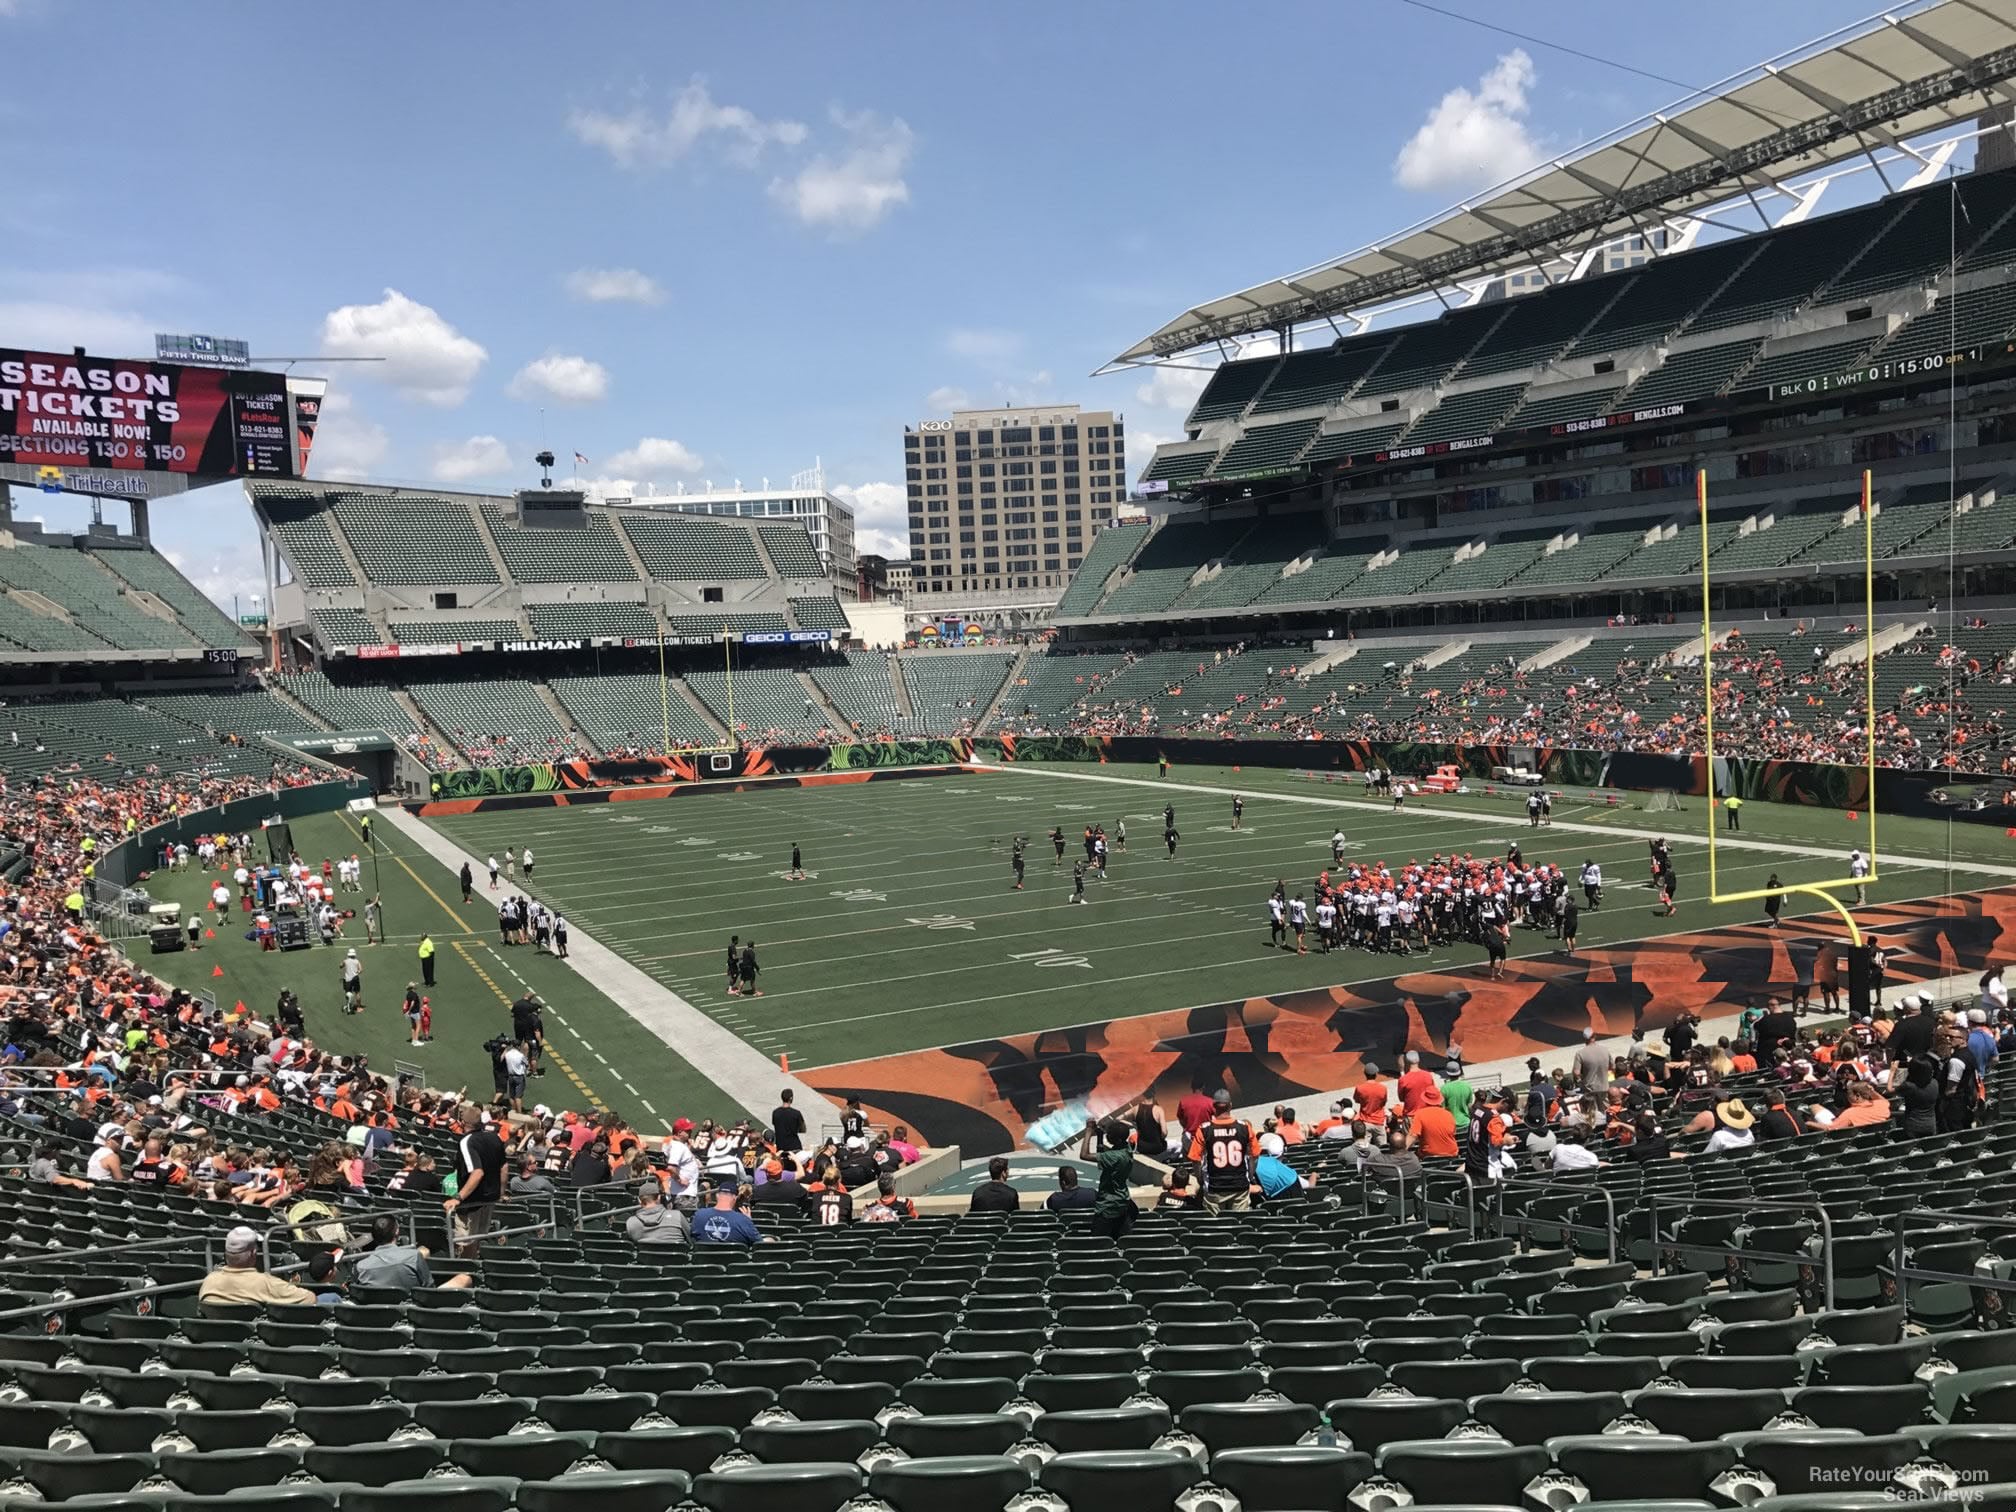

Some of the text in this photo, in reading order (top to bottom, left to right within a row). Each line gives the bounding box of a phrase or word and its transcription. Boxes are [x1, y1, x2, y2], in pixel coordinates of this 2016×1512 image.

[221, 355, 247, 364] BANK
[1898, 355, 1943, 375] 15:00
[1969, 349, 1976, 359] 1
[1, 361, 170, 397] SEASON
[1836, 368, 1879, 386] WHT 0
[1781, 379, 1817, 396] BLK 0
[0, 388, 180, 422] TICKETS
[246, 400, 274, 410] TICKETS
[1634, 404, 1684, 421] BENGALS.COM
[32, 418, 151, 441] AVAILABLE NOW!
[0, 434, 186, 461] SECTIONS 130 & 150
[1450, 436, 1493, 451] BENGALS.COM
[67, 473, 150, 494] TriHealth
[503, 640, 582, 651] HILLMAN
[746, 631, 828, 643] GEICO GEICO
[1212, 1140, 1242, 1168] 96
[819, 1204, 840, 1226] 18
